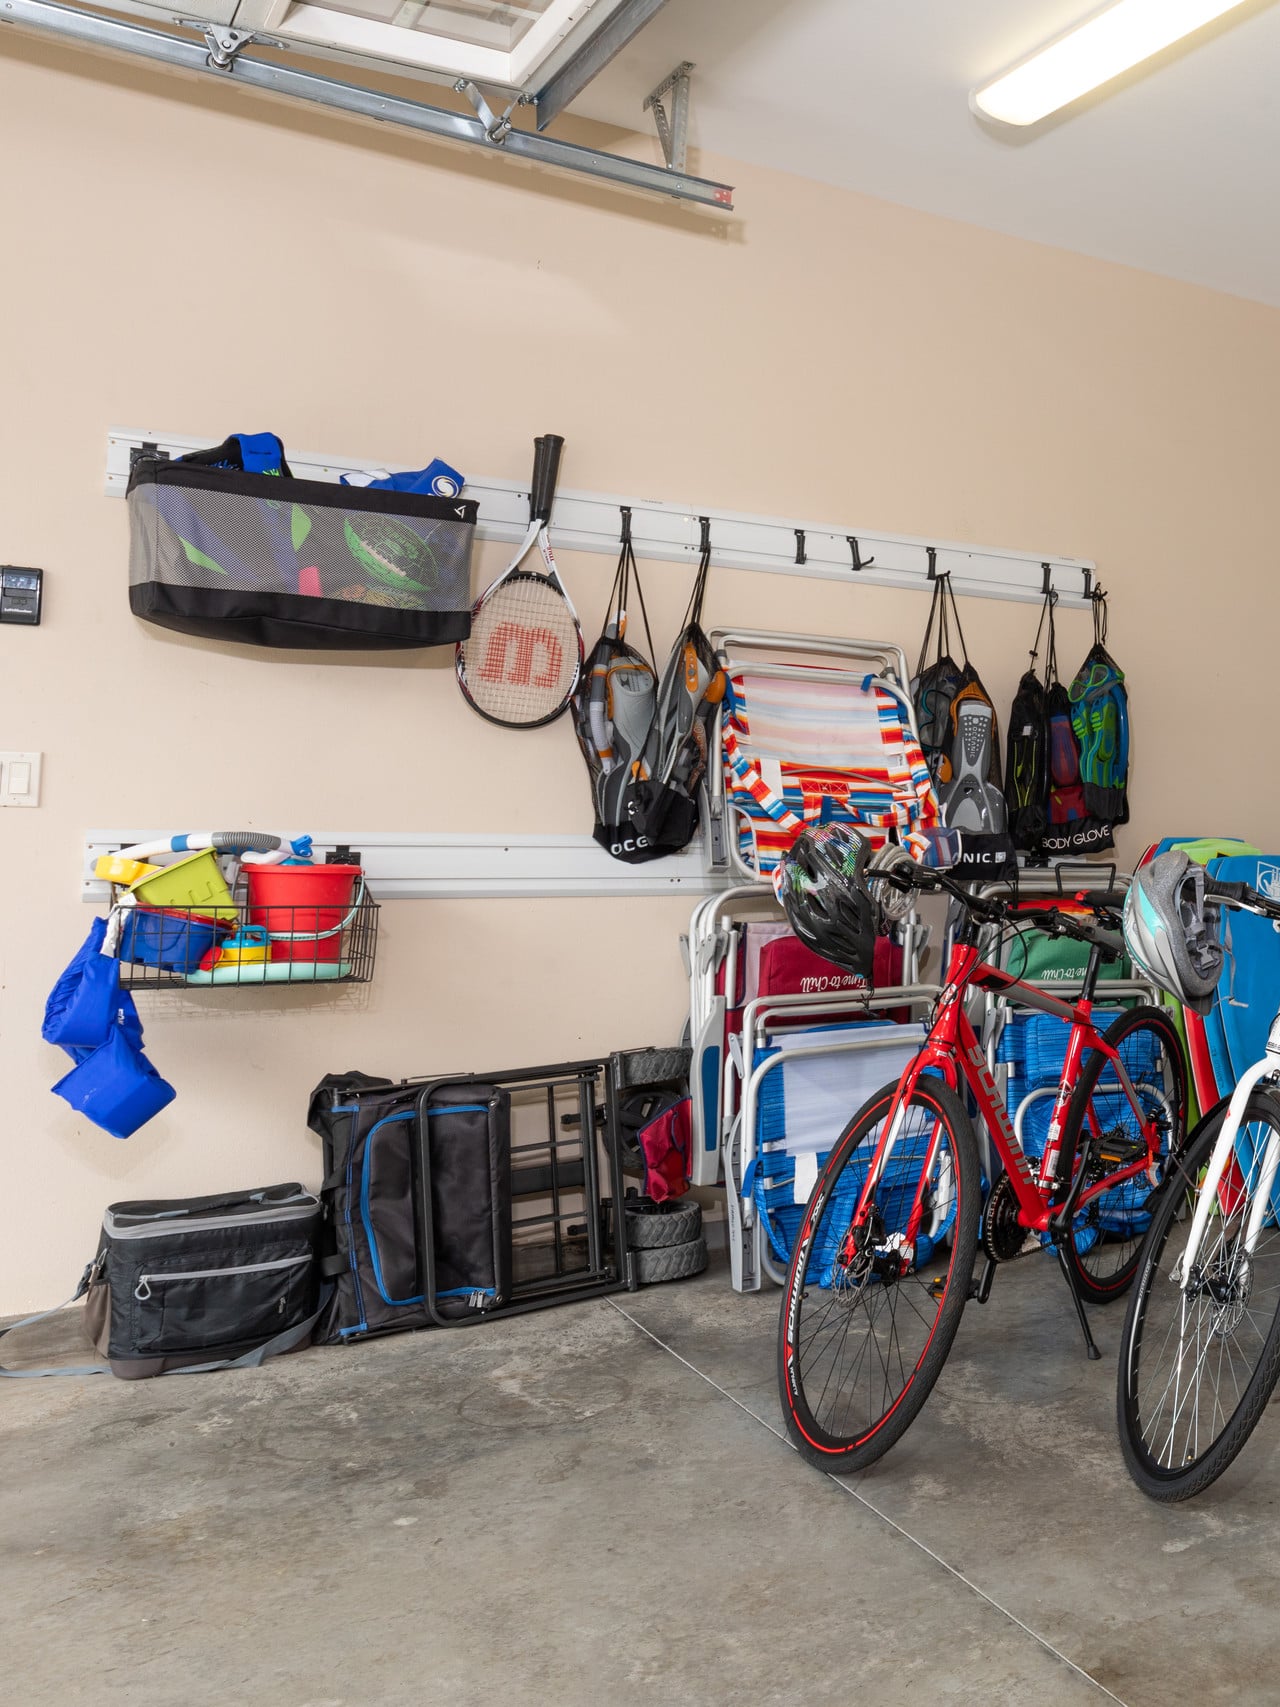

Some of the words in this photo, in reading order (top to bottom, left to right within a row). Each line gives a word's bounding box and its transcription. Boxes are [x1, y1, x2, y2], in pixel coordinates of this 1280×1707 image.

[611, 835, 649, 855] OCE
[1042, 836, 1071, 849] BODY
[1072, 825, 1110, 845] GLOVE
[963, 852, 991, 864] NIC
[800, 976, 828, 992] Chill
[829, 975, 840, 989] to
[968, 1044, 1034, 1184] SCHWINN
[787, 1250, 805, 1344] SCHWINN
